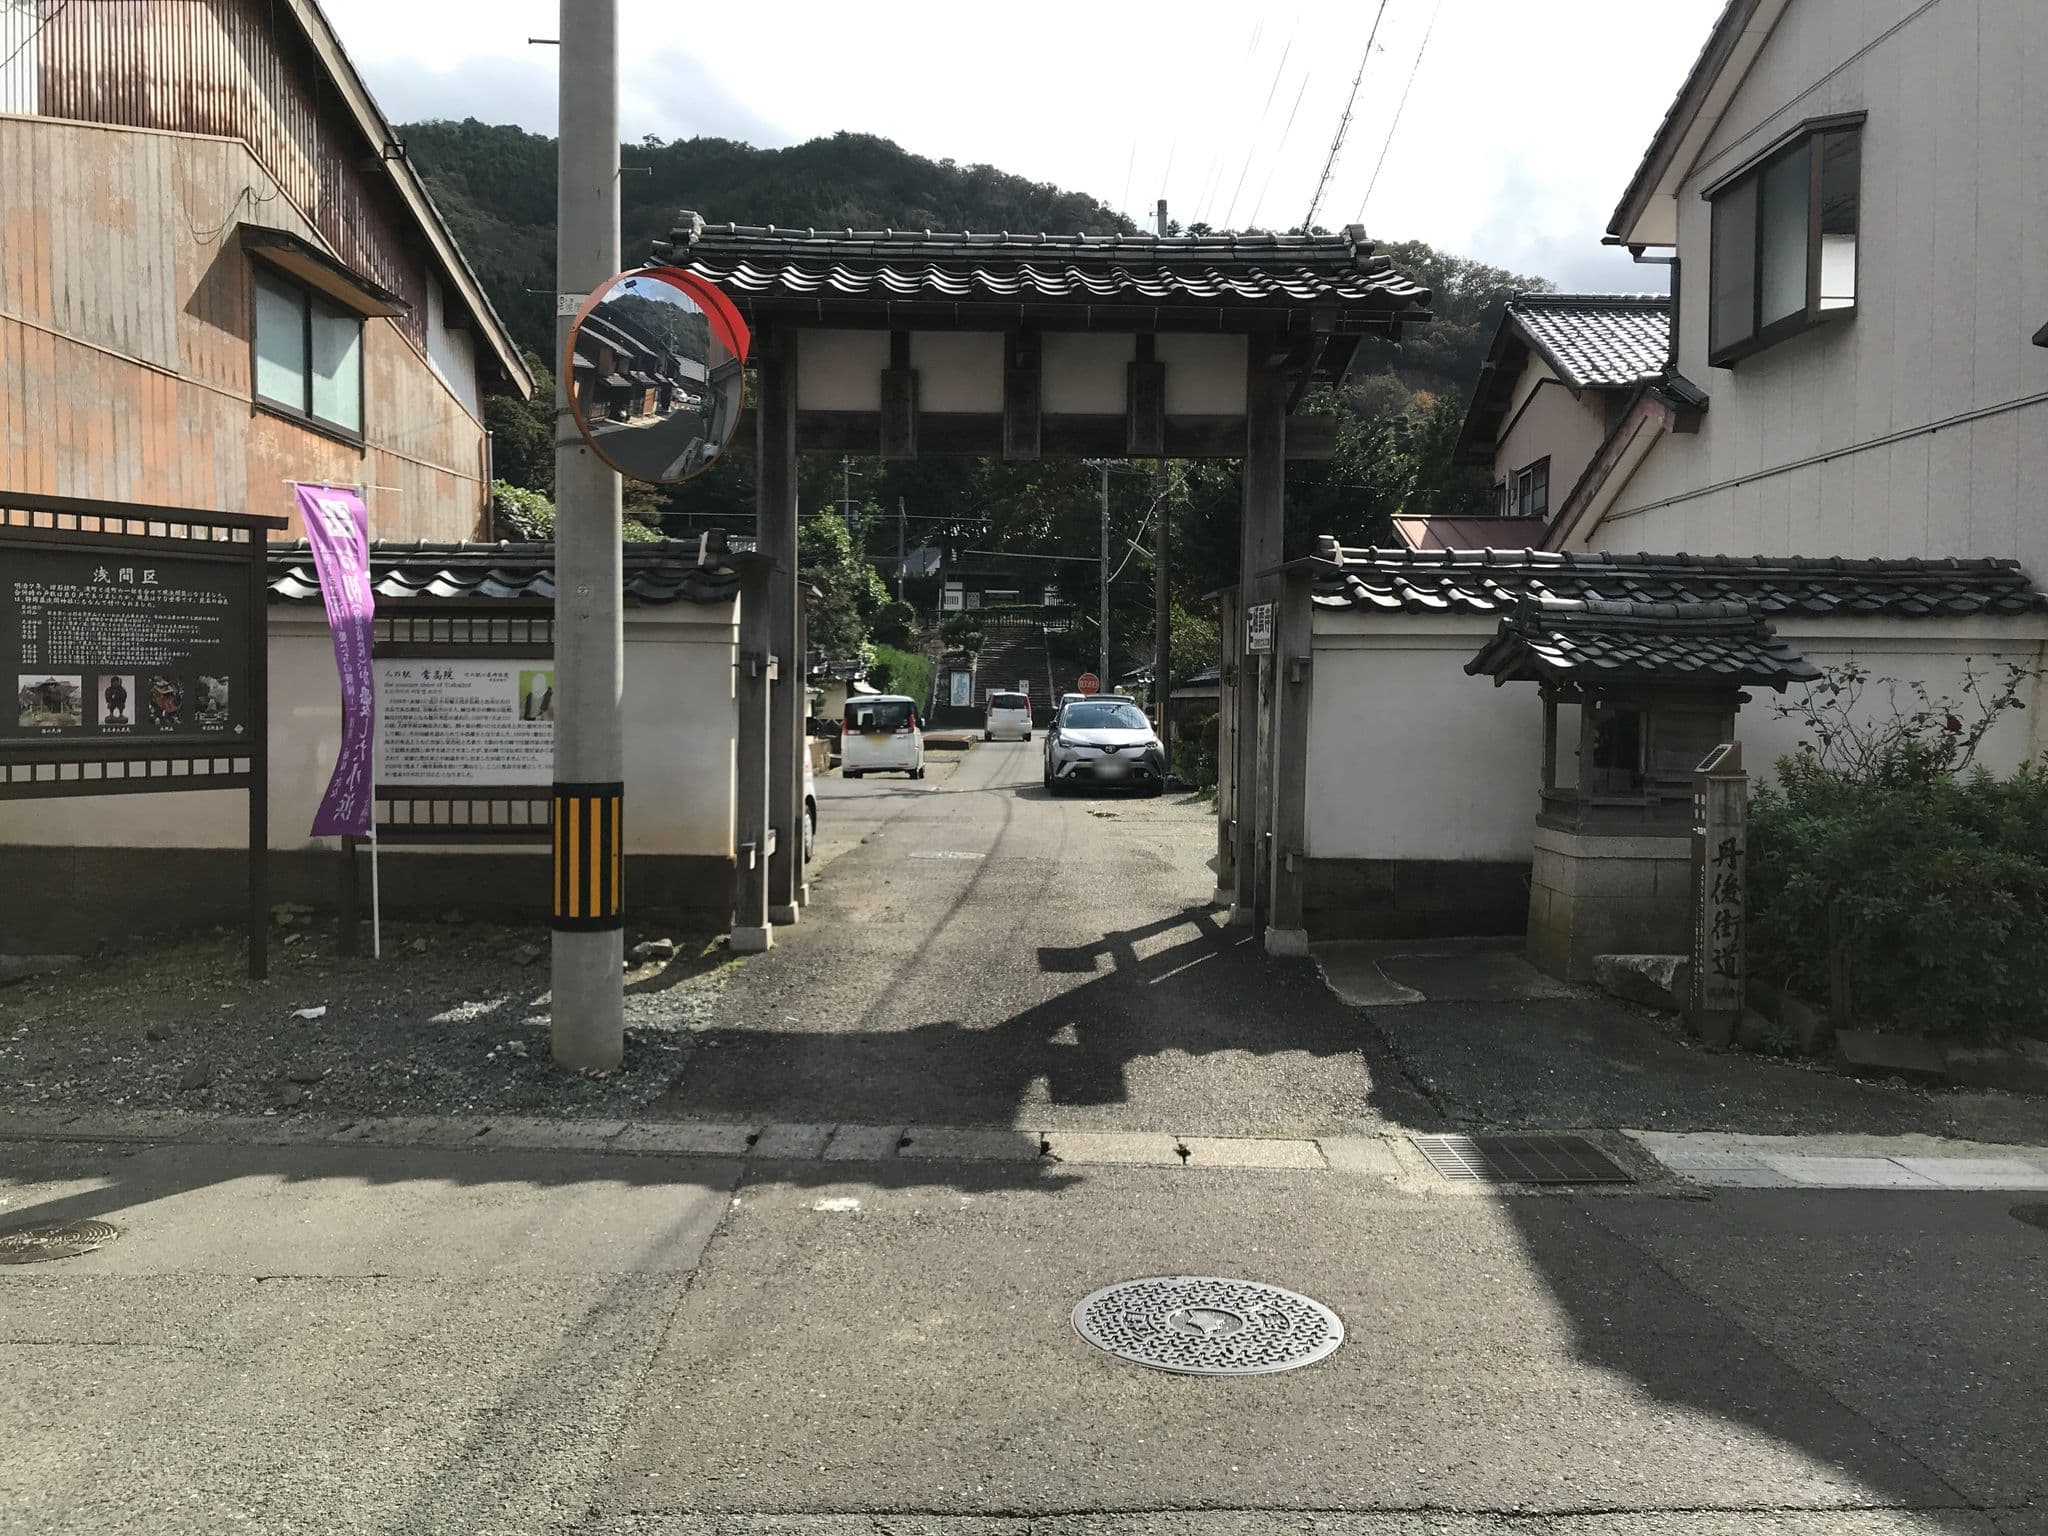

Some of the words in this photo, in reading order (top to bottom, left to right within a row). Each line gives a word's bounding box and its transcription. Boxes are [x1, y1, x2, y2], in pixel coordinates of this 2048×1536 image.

[93, 566, 159, 585] 浅間区
[1710, 837, 1745, 981] 丹後街道
